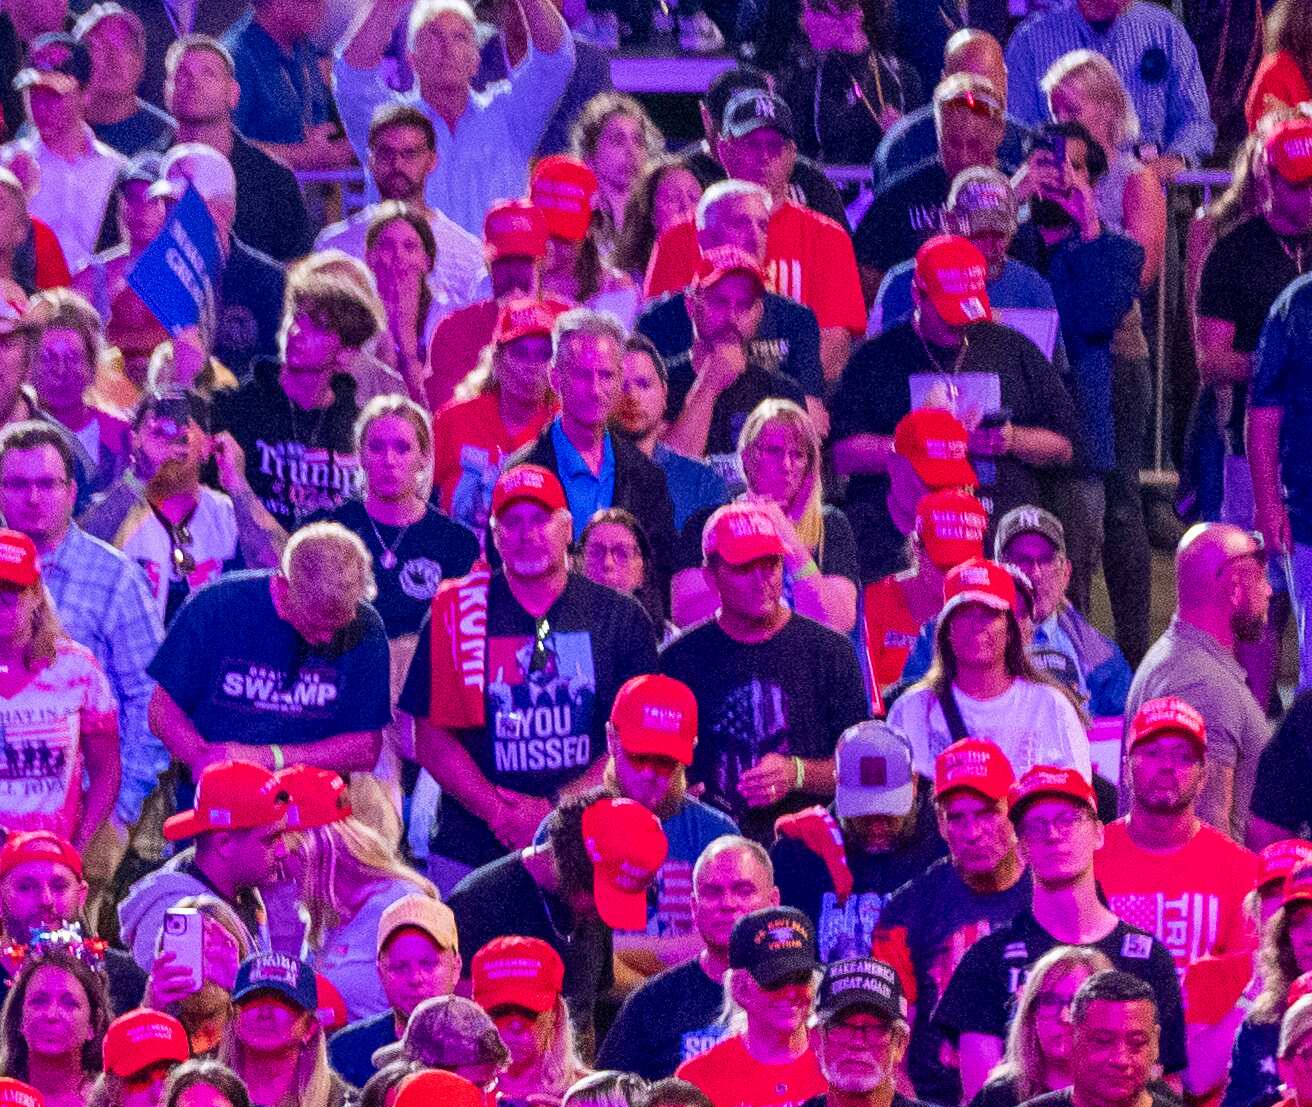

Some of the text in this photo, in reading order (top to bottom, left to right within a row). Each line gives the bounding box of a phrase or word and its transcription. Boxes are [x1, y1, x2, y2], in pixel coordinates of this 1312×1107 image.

[222, 672, 337, 703] SWAMP
[520, 708, 572, 740] YOU
[495, 734, 591, 774] MISSED
[829, 961, 896, 983] MAKE AMERICA
[831, 977, 893, 999] GREAT AGAIN
